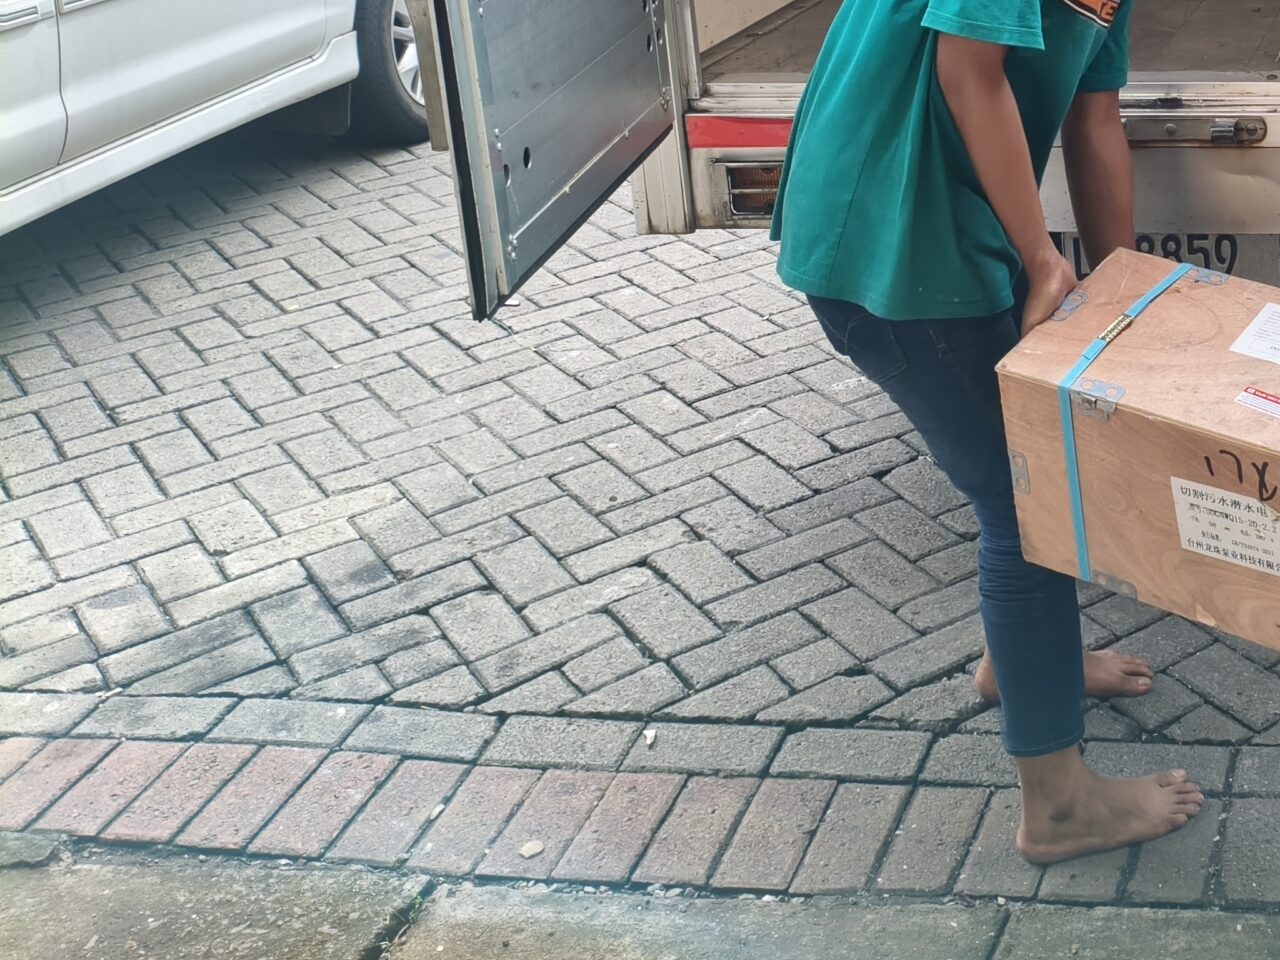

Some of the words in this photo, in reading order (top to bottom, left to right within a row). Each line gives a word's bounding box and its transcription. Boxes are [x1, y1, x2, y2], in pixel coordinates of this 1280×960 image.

[1181, 485, 1280, 522] 切割污水潜水电
